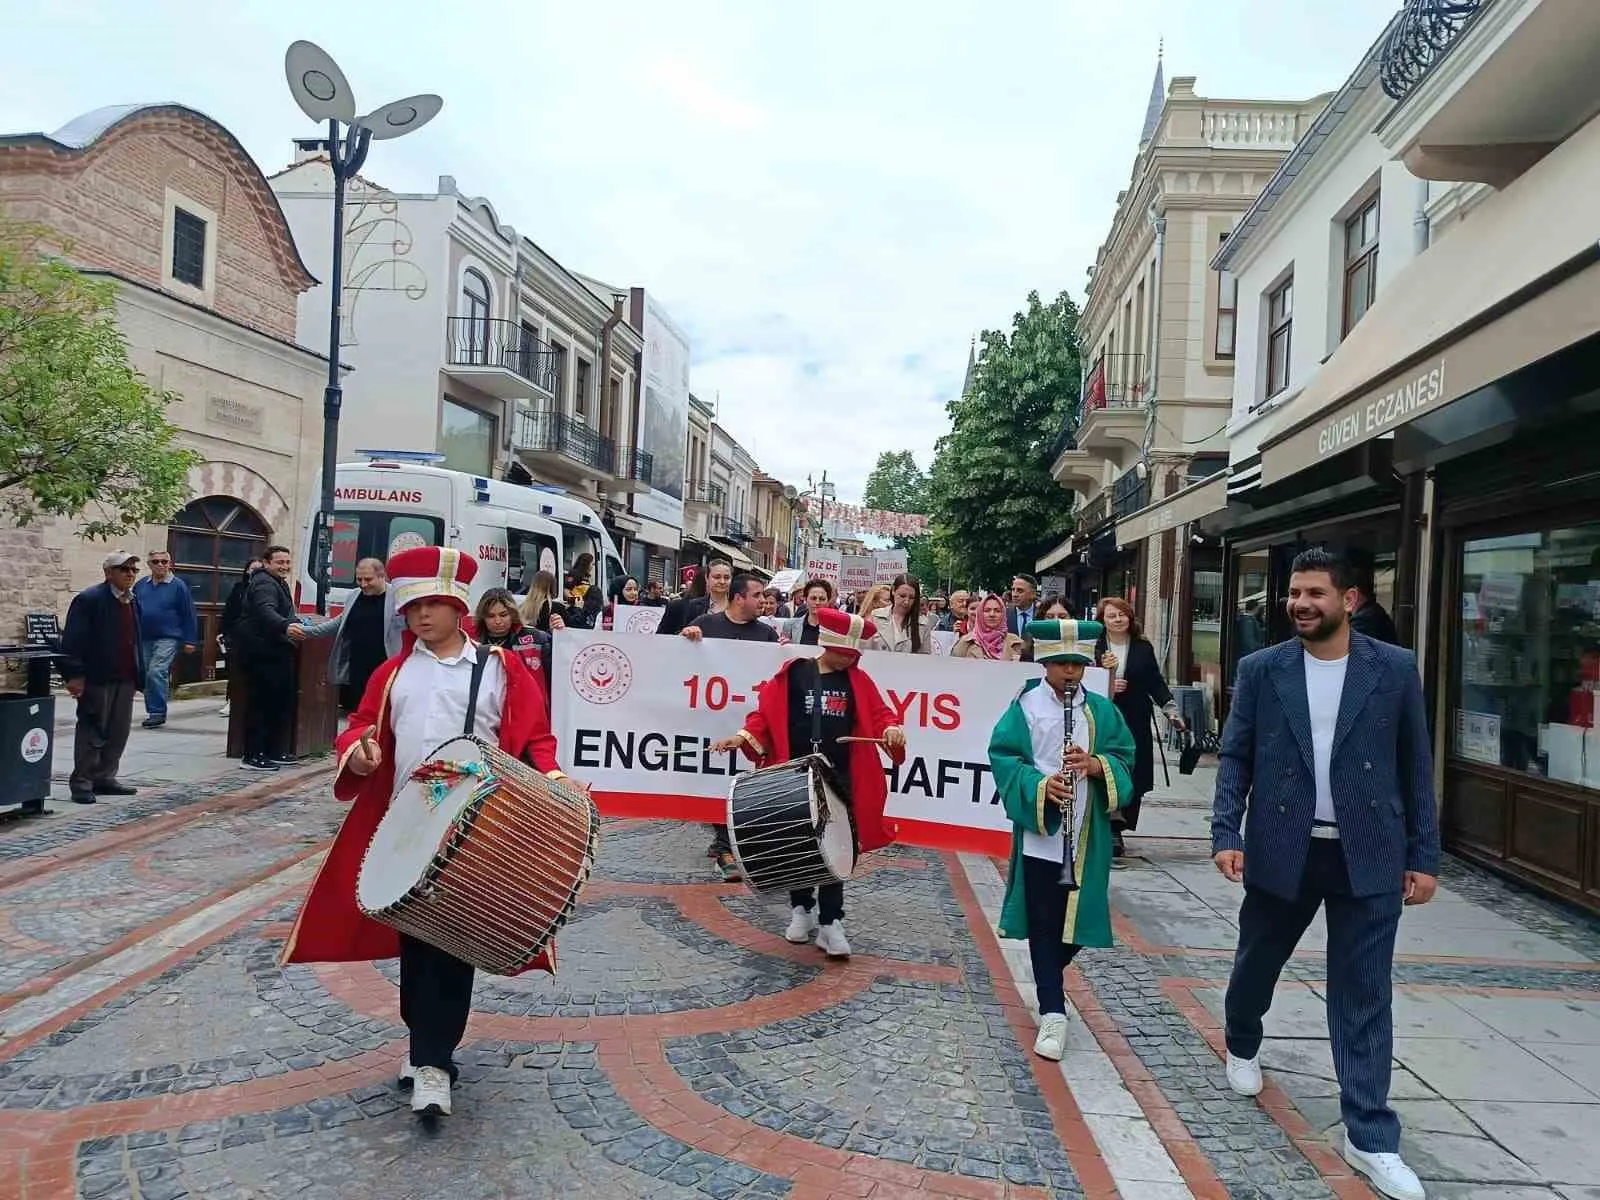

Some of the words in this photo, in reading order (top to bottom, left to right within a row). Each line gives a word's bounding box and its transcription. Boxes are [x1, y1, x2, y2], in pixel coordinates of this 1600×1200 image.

[1366, 359, 1446, 432] ECZANESİ
[335, 487, 423, 503] AMBULANS
[826, 561, 838, 572] DE
[807, 689, 848, 697] TMMY
